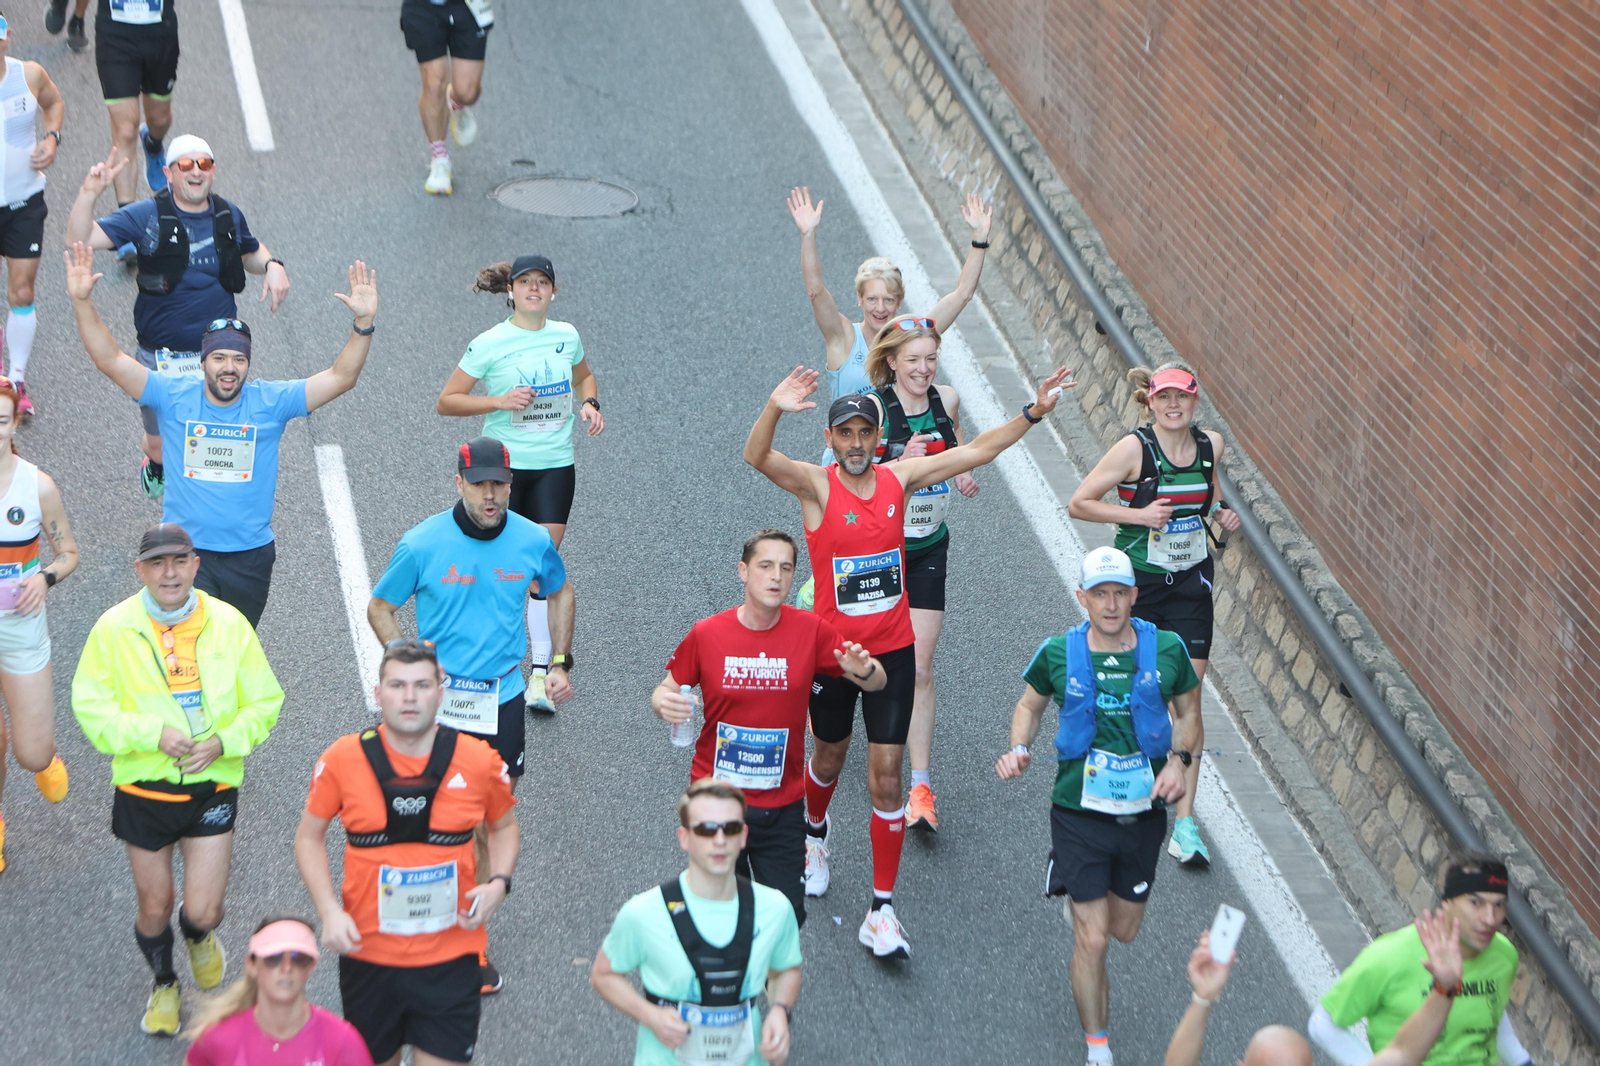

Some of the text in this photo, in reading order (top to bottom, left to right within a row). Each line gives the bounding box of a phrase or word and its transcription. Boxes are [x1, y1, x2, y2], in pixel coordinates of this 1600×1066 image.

[179, 363, 201, 372] 10064
[536, 384, 566, 395] ZURICH
[545, 412, 562, 420] KART
[210, 427, 247, 438] ZURICH
[207, 447, 233, 456] 10073
[204, 459, 234, 468] CONCHA
[910, 503, 933, 513] 10669
[911, 516, 932, 525] CARLA
[1172, 521, 1200, 531] ZURICH
[1169, 541, 1191, 550] 10659
[858, 555, 892, 569] ZURICH
[1167, 553, 1191, 561] TRACEY
[859, 577, 880, 589] 3139
[857, 589, 885, 601] MAZISA
[723, 666, 748, 679] 70.3
[454, 679, 490, 690] ZURICH
[177, 694, 200, 705] RICH
[450, 699, 475, 710] 10075
[443, 709, 481, 720] MANOLOM
[741, 732, 779, 742] ZURICH
[737, 750, 764, 764] 12500
[717, 759, 781, 775] AXEL JURGENSEN
[1110, 758, 1143, 771] ZURICH
[1108, 780, 1130, 789] 5397
[406, 868, 447, 884] ZURICH
